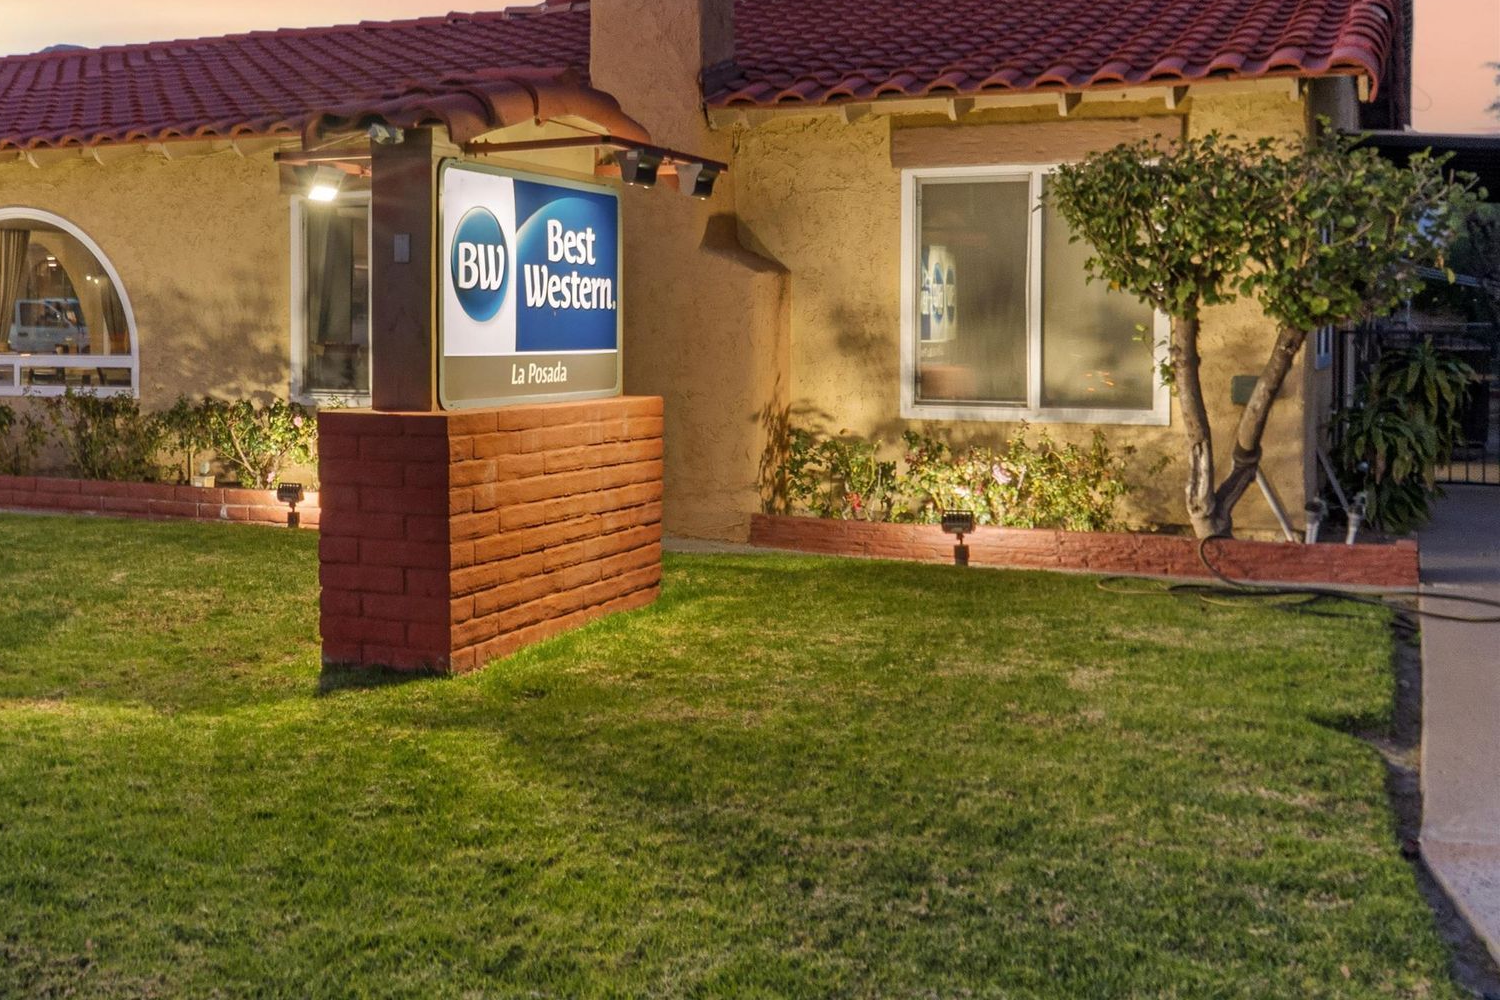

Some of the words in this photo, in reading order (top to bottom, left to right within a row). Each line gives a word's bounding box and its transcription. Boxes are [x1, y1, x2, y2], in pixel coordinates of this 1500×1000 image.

[546, 219, 596, 265] Best
[457, 241, 505, 291] BW
[511, 363, 525, 385] La
[528, 360, 567, 384] Posada
